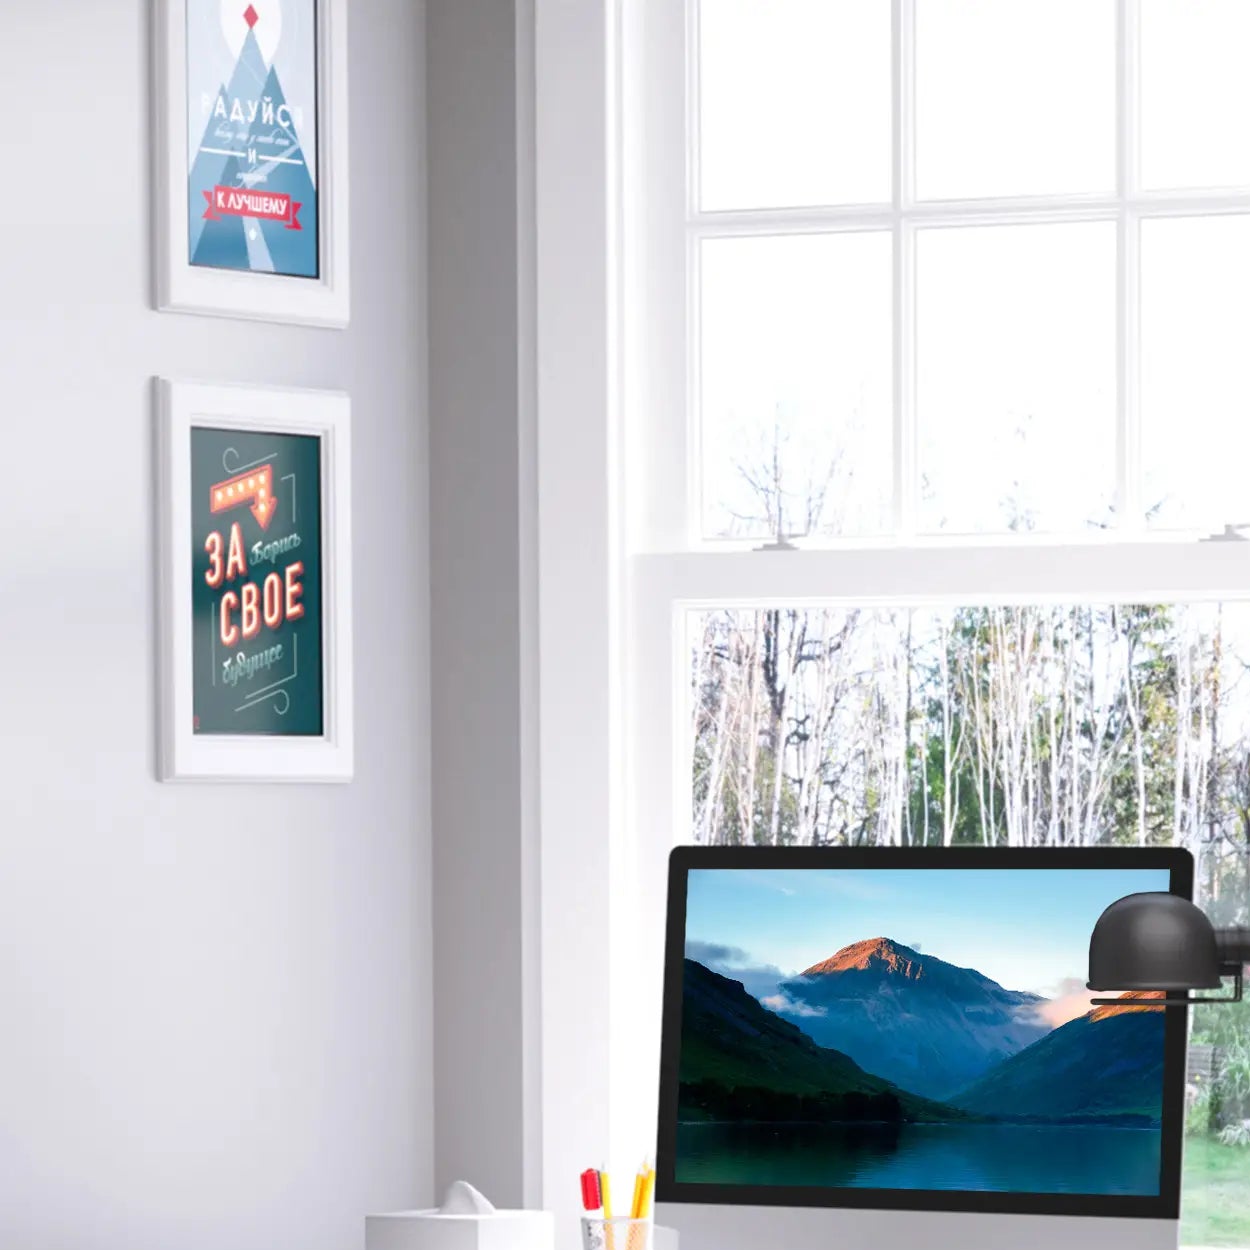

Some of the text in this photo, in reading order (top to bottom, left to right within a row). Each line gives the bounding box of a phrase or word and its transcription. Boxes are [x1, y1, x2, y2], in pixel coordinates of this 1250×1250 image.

[217, 191, 288, 216] К ЛУЧШЕМУ
[205, 521, 247, 588] ЗА
[220, 561, 304, 646] СВОЕ
